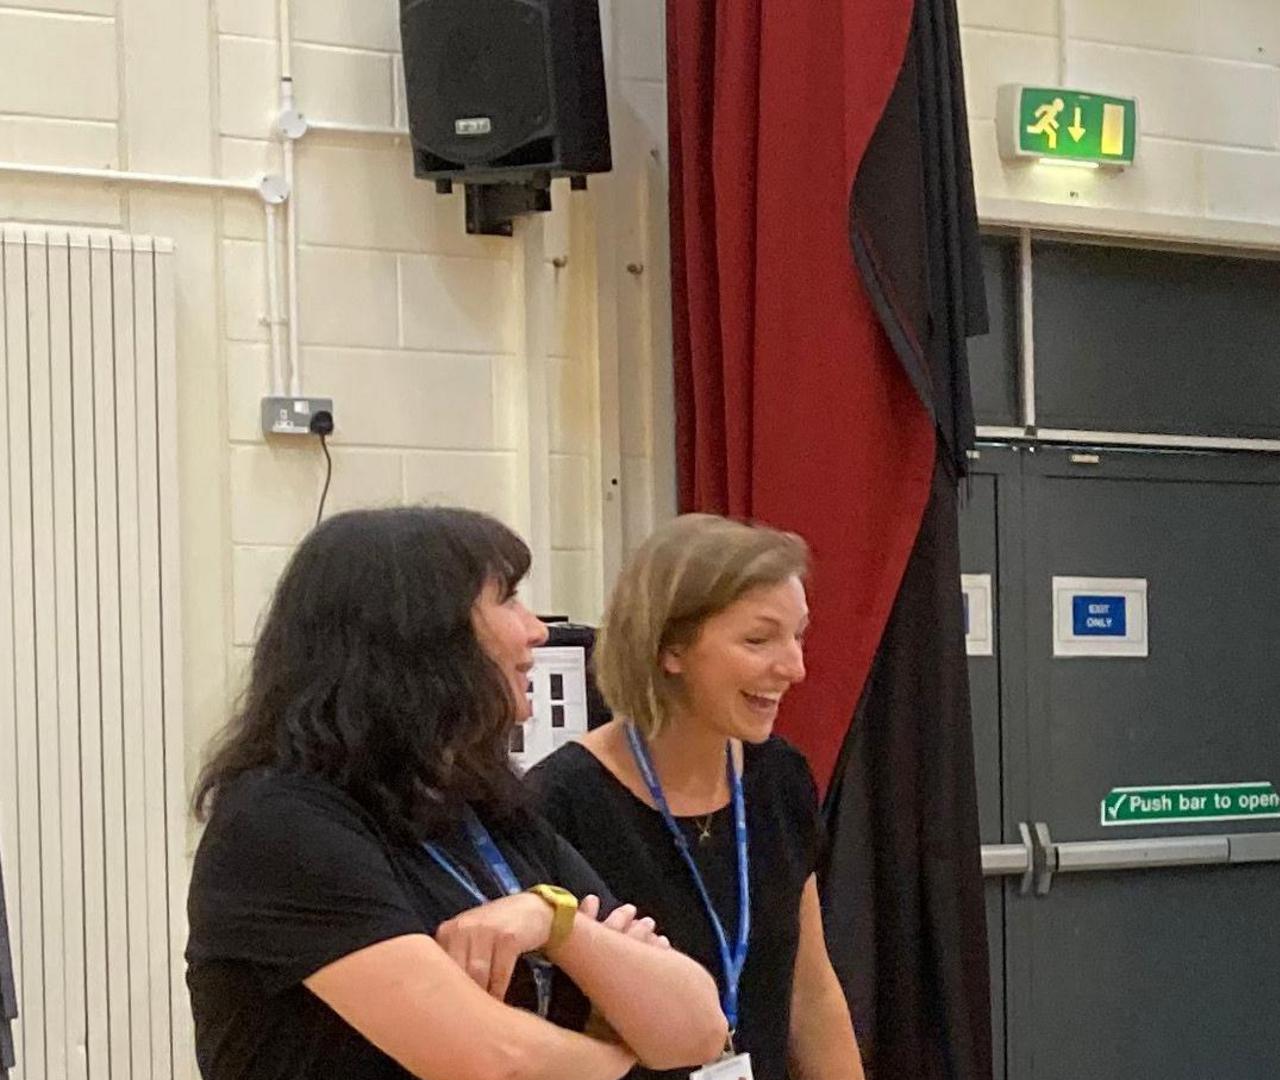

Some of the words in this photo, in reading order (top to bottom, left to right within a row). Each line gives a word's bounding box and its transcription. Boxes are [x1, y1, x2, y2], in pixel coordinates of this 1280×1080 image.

[1088, 604, 1110, 614] EXIT
[1086, 617, 1112, 628] ONLY
[1130, 794, 1172, 812] Push
[1179, 793, 1206, 811] bar
[1214, 793, 1231, 809] to
[1238, 793, 1279, 810] open
